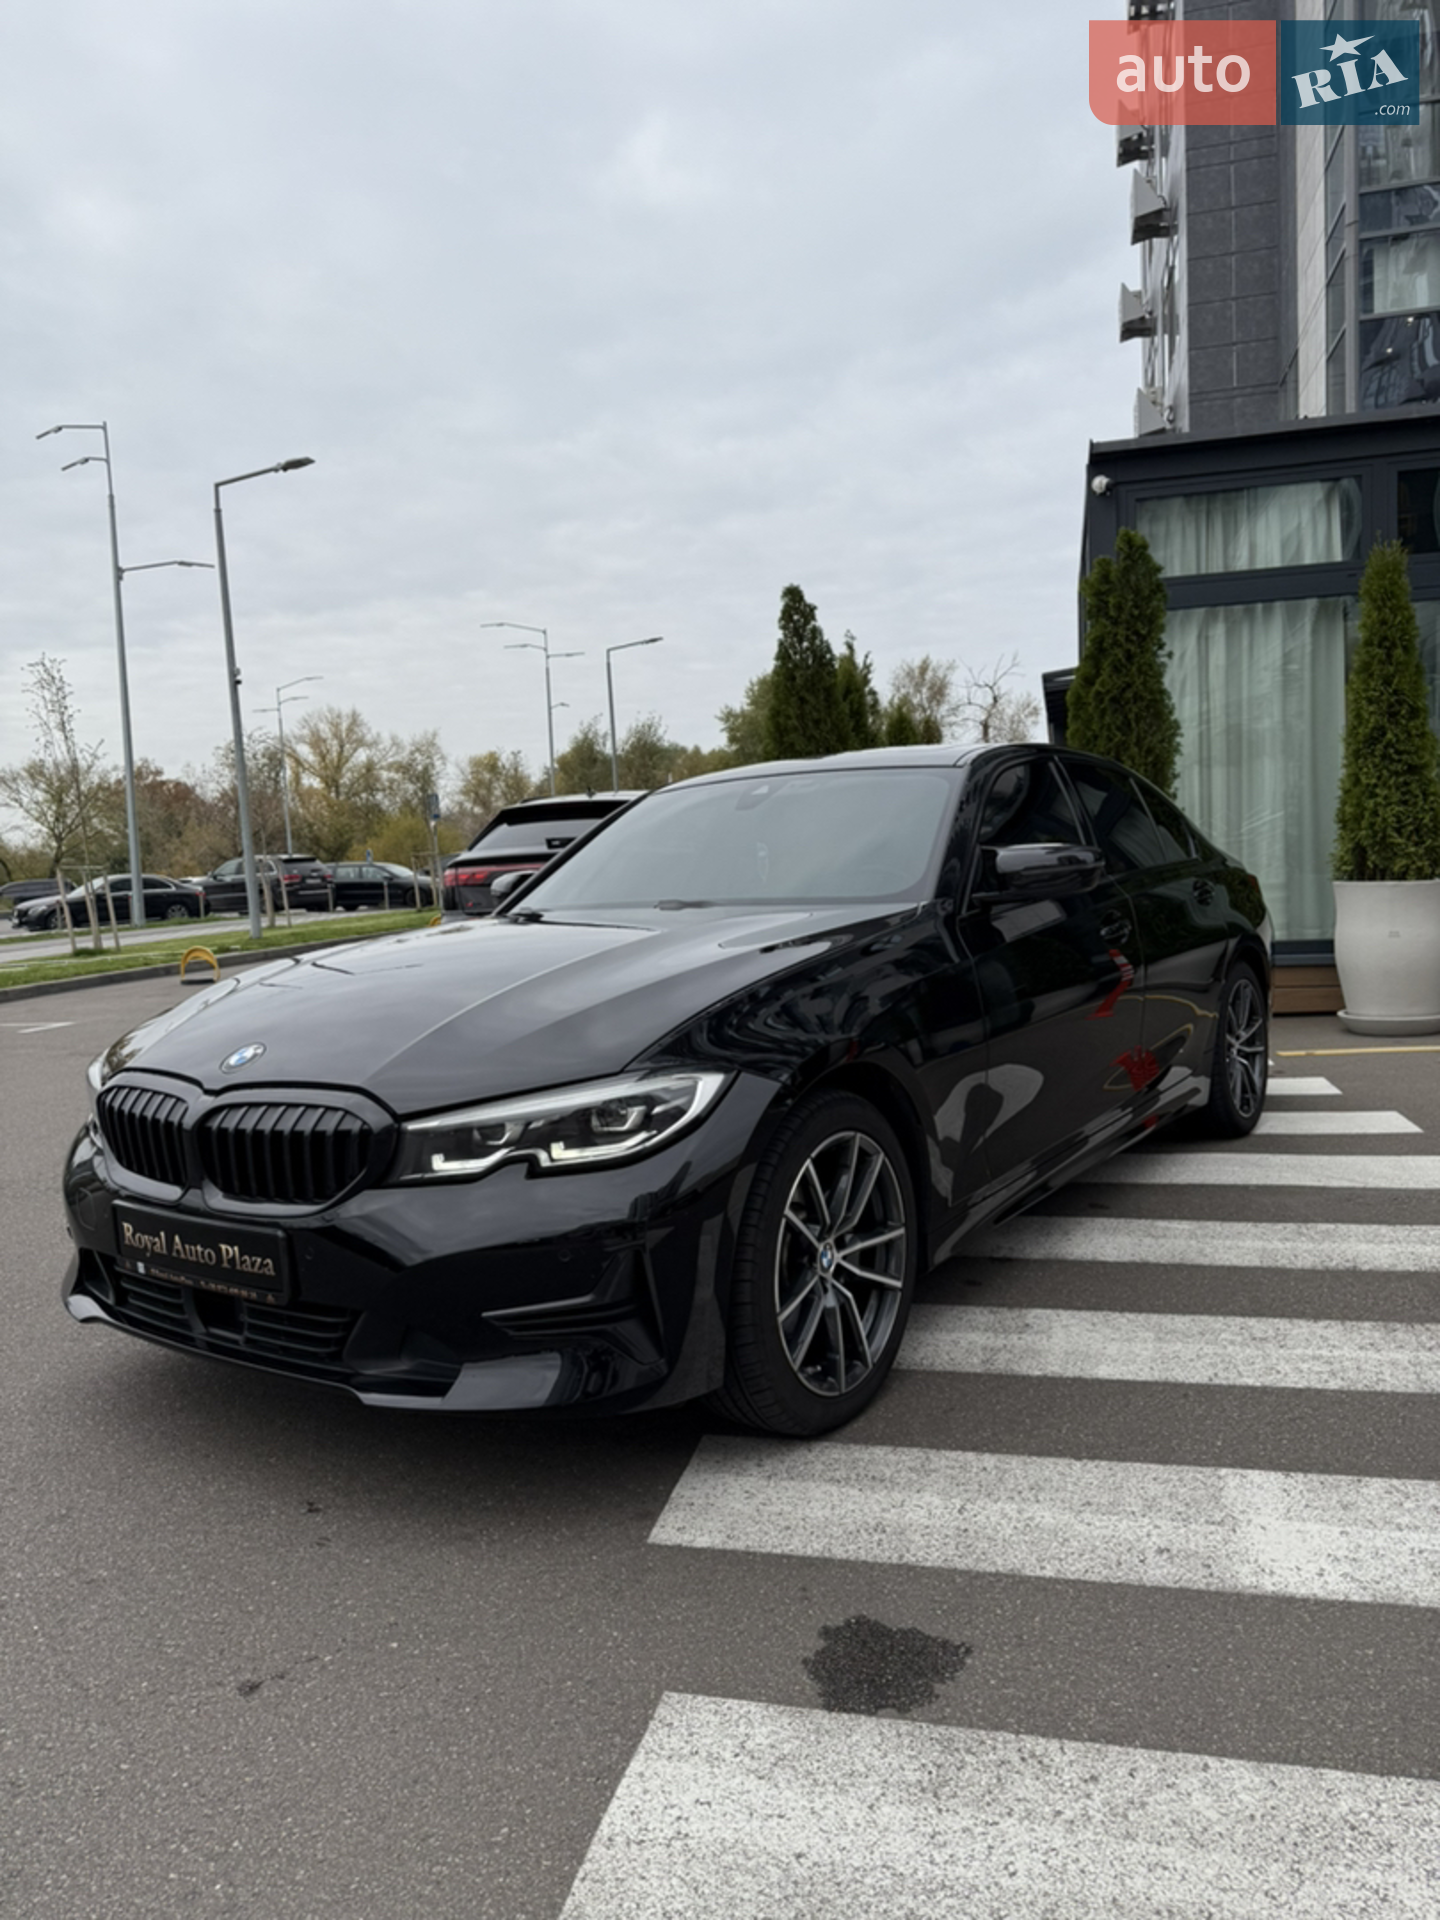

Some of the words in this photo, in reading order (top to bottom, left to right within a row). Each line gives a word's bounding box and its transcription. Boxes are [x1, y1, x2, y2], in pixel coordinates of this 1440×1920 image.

[122, 1221, 167, 1257] Royal
[171, 1234, 216, 1266] Auto
[218, 1243, 276, 1277] Plaza
